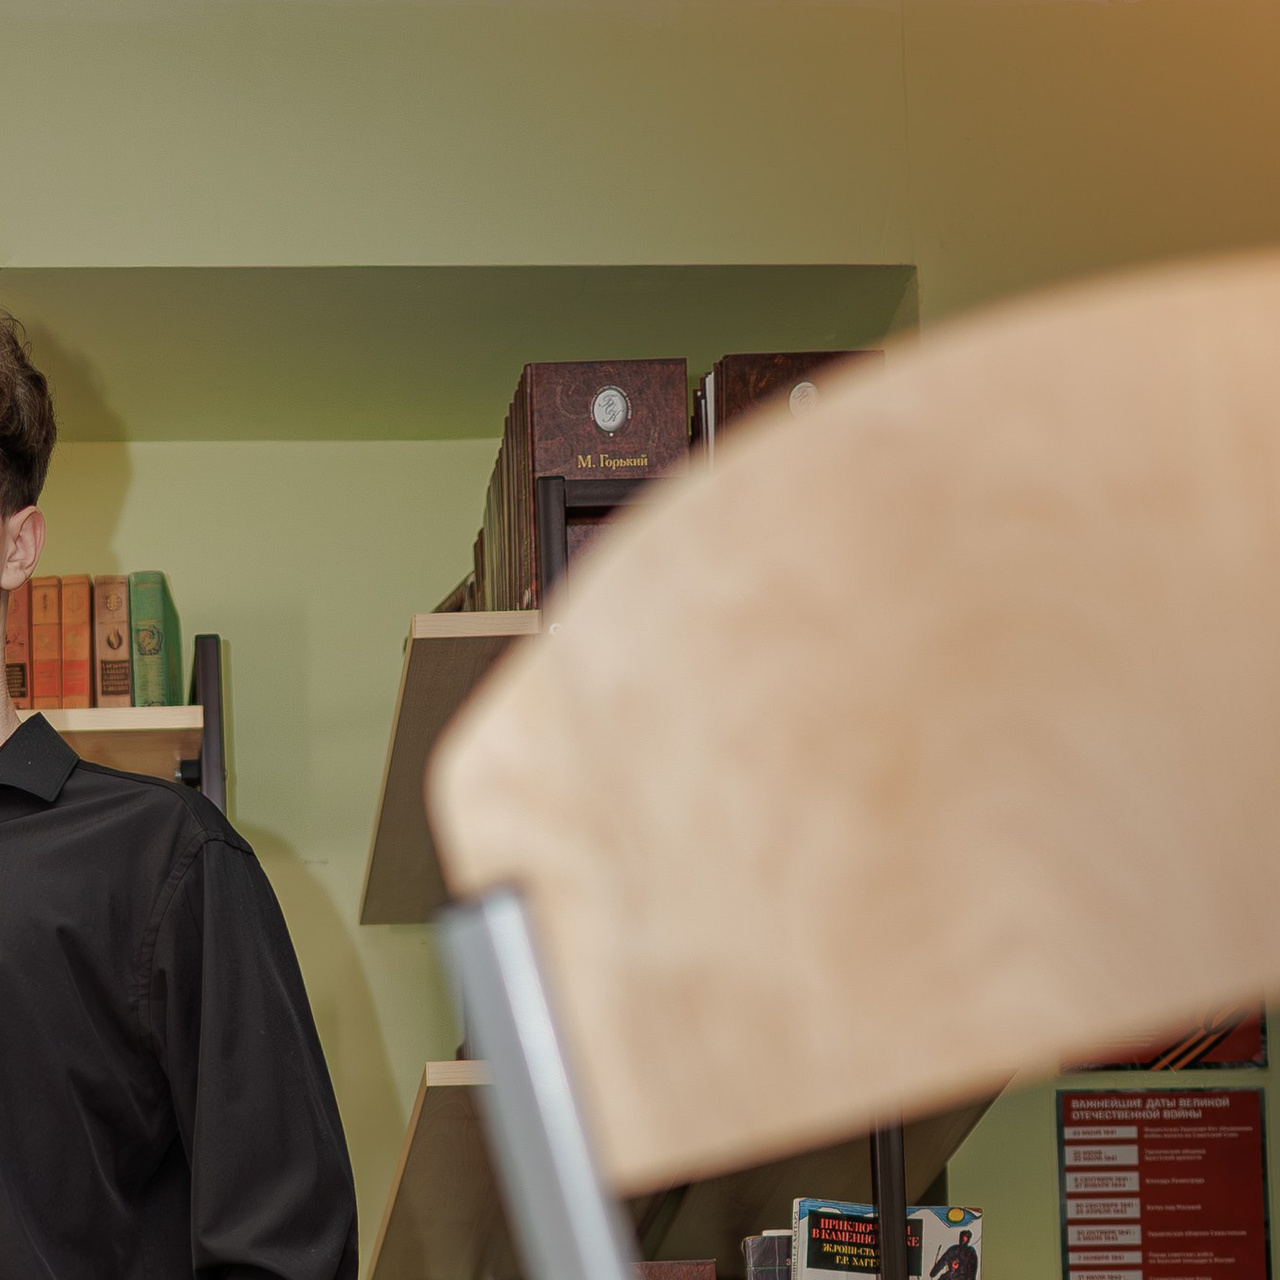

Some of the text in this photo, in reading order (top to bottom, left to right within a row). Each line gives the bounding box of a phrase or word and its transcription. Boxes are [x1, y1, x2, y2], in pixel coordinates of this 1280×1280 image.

[577, 453, 648, 470] М. Горький
[1070, 1096, 1230, 1110] ВАЖНЕЙШИЕ ДАТЫ ВЕЛИКОЙ
[1071, 1108, 1203, 1120] ОТЕЧЕСТВЕННОЙ ВОЙНЫ
[812, 1228, 820, 1239] В
[821, 1228, 877, 1246] КАМЕННО
